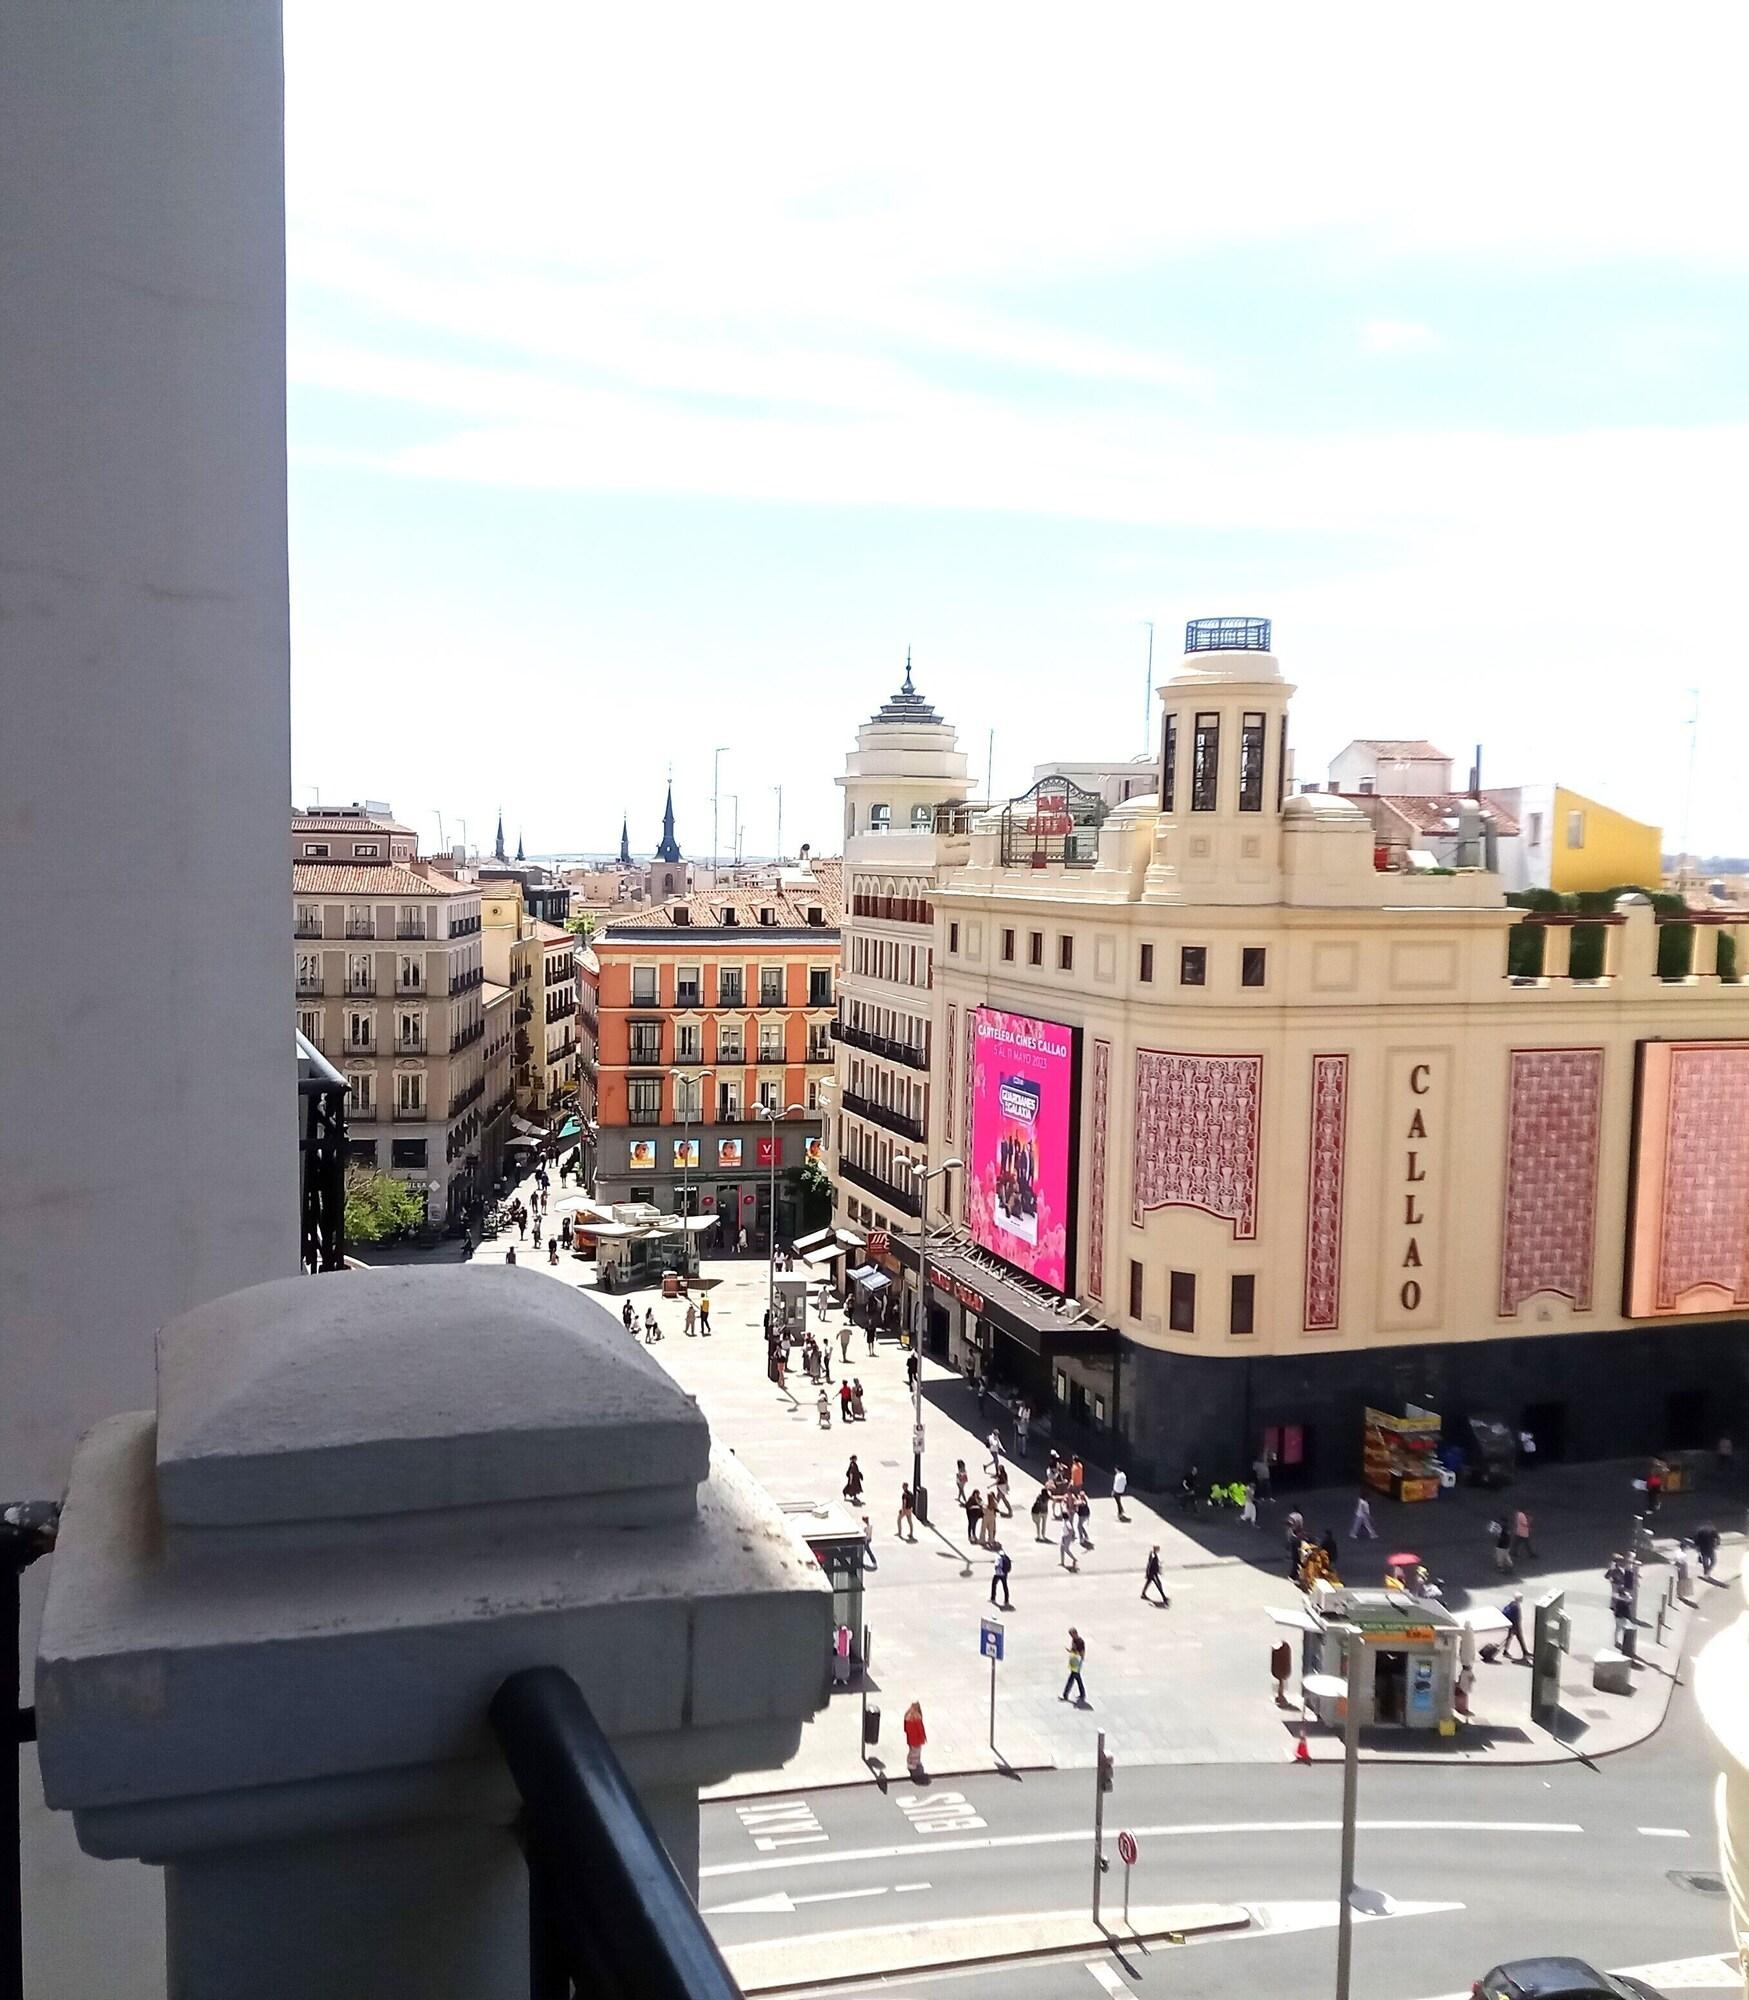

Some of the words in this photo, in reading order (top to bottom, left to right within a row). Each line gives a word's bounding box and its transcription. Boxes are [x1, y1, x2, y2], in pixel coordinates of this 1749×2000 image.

[978, 1024, 1015, 1044] CARTELERA
[1015, 1034, 1037, 1050] CINES
[1037, 1040, 1067, 1058] CALLAO
[1013, 1049, 1031, 1065] MAYO
[1401, 1064, 1431, 1311] CALLAO
[735, 1801, 830, 1851] TAXI
[895, 1791, 988, 1834] BUS
